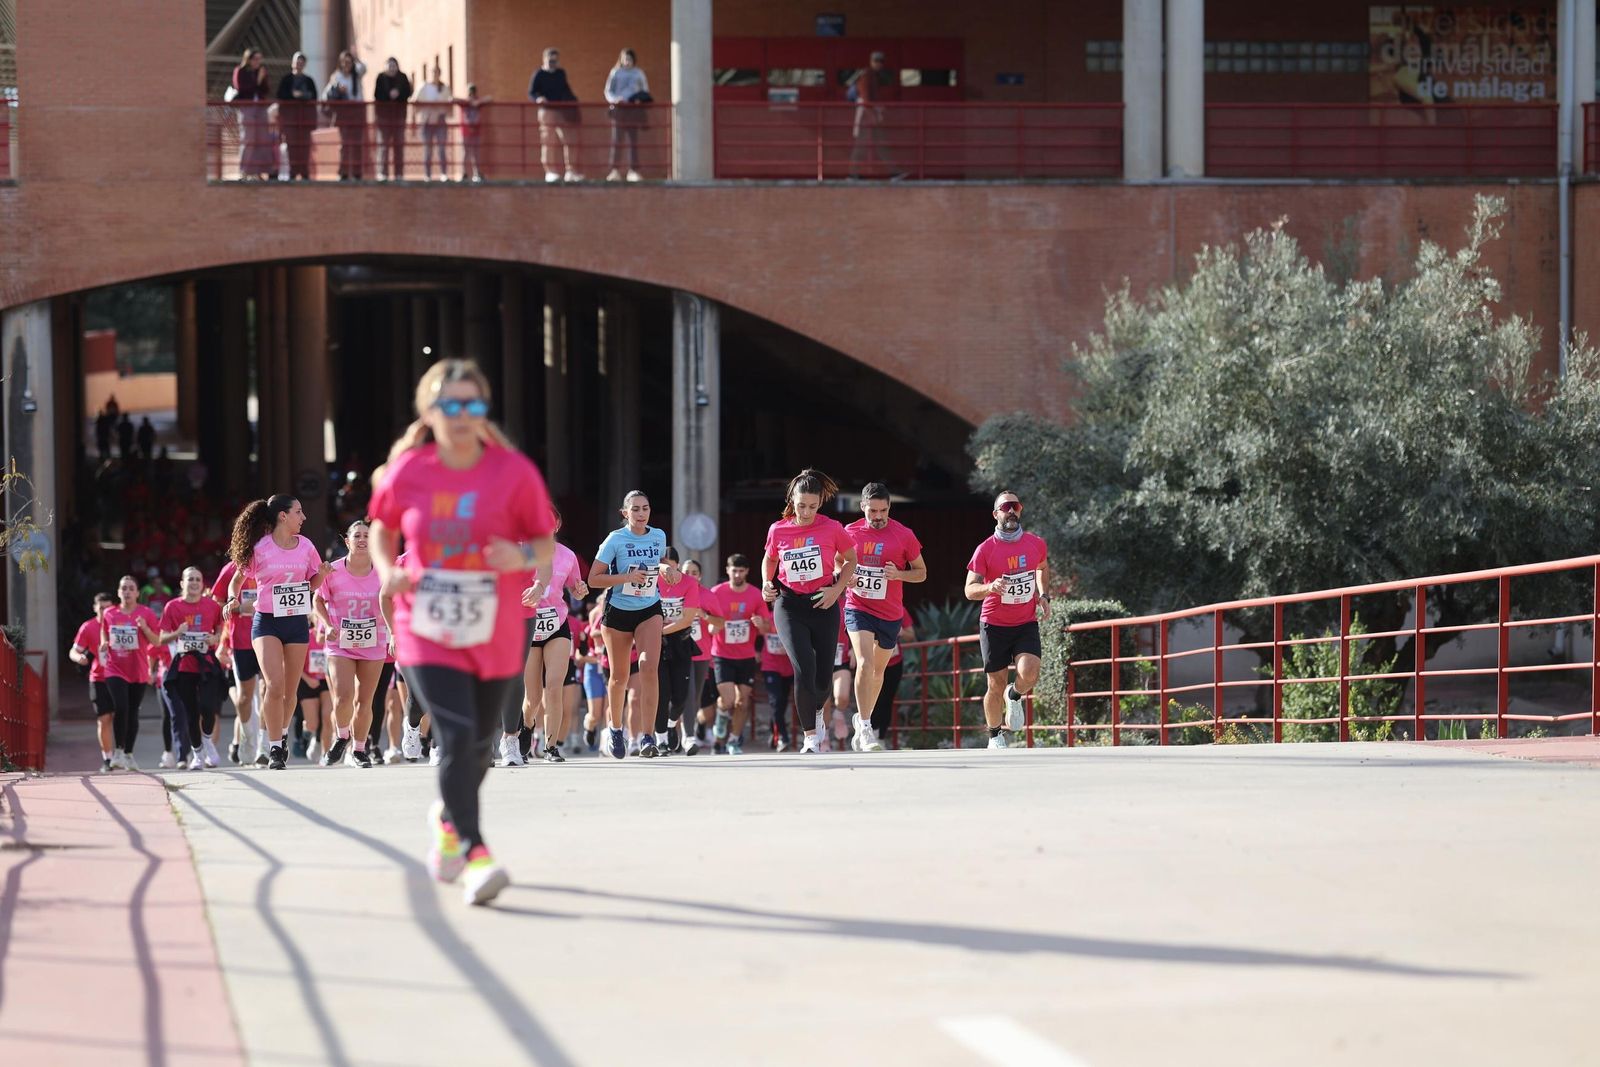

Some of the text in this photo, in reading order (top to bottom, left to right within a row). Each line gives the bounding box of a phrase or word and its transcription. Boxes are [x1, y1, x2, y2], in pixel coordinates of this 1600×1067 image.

[1381, 33, 1422, 64] de
[1408, 51, 1545, 75] universidad
[1418, 75, 1545, 103] de málaga
[793, 536, 814, 548] WE
[863, 541, 884, 555] WE
[627, 545, 659, 558] nerja
[784, 553, 801, 561] UMA
[791, 558, 817, 572] 446
[1007, 554, 1027, 569] WE
[274, 586, 291, 594] UMA
[857, 576, 882, 590] 616
[1007, 582, 1031, 596] 435
[279, 593, 305, 607] 482
[348, 599, 371, 619] 22
[428, 597, 481, 625] 635
[534, 618, 555, 632] 46
[115, 635, 134, 644] 360
[346, 629, 372, 641] 356
[184, 642, 204, 651] 684
